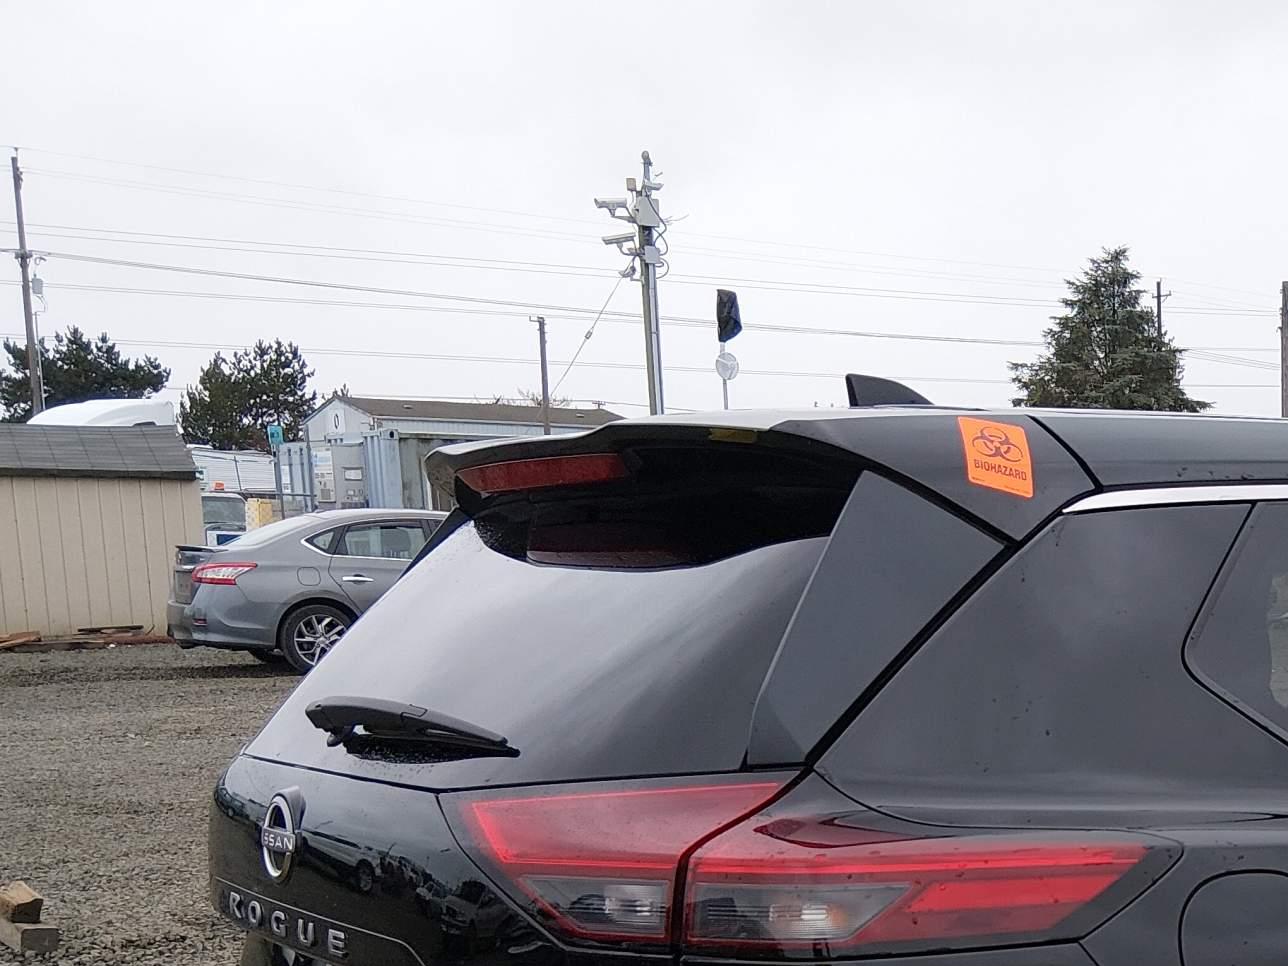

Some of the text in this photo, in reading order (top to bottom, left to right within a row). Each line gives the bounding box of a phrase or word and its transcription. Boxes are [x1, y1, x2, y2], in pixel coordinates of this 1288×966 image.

[973, 458, 1027, 481] BIOHAZARD
[263, 832, 293, 850] SSAN
[228, 891, 348, 958] ROGUE
